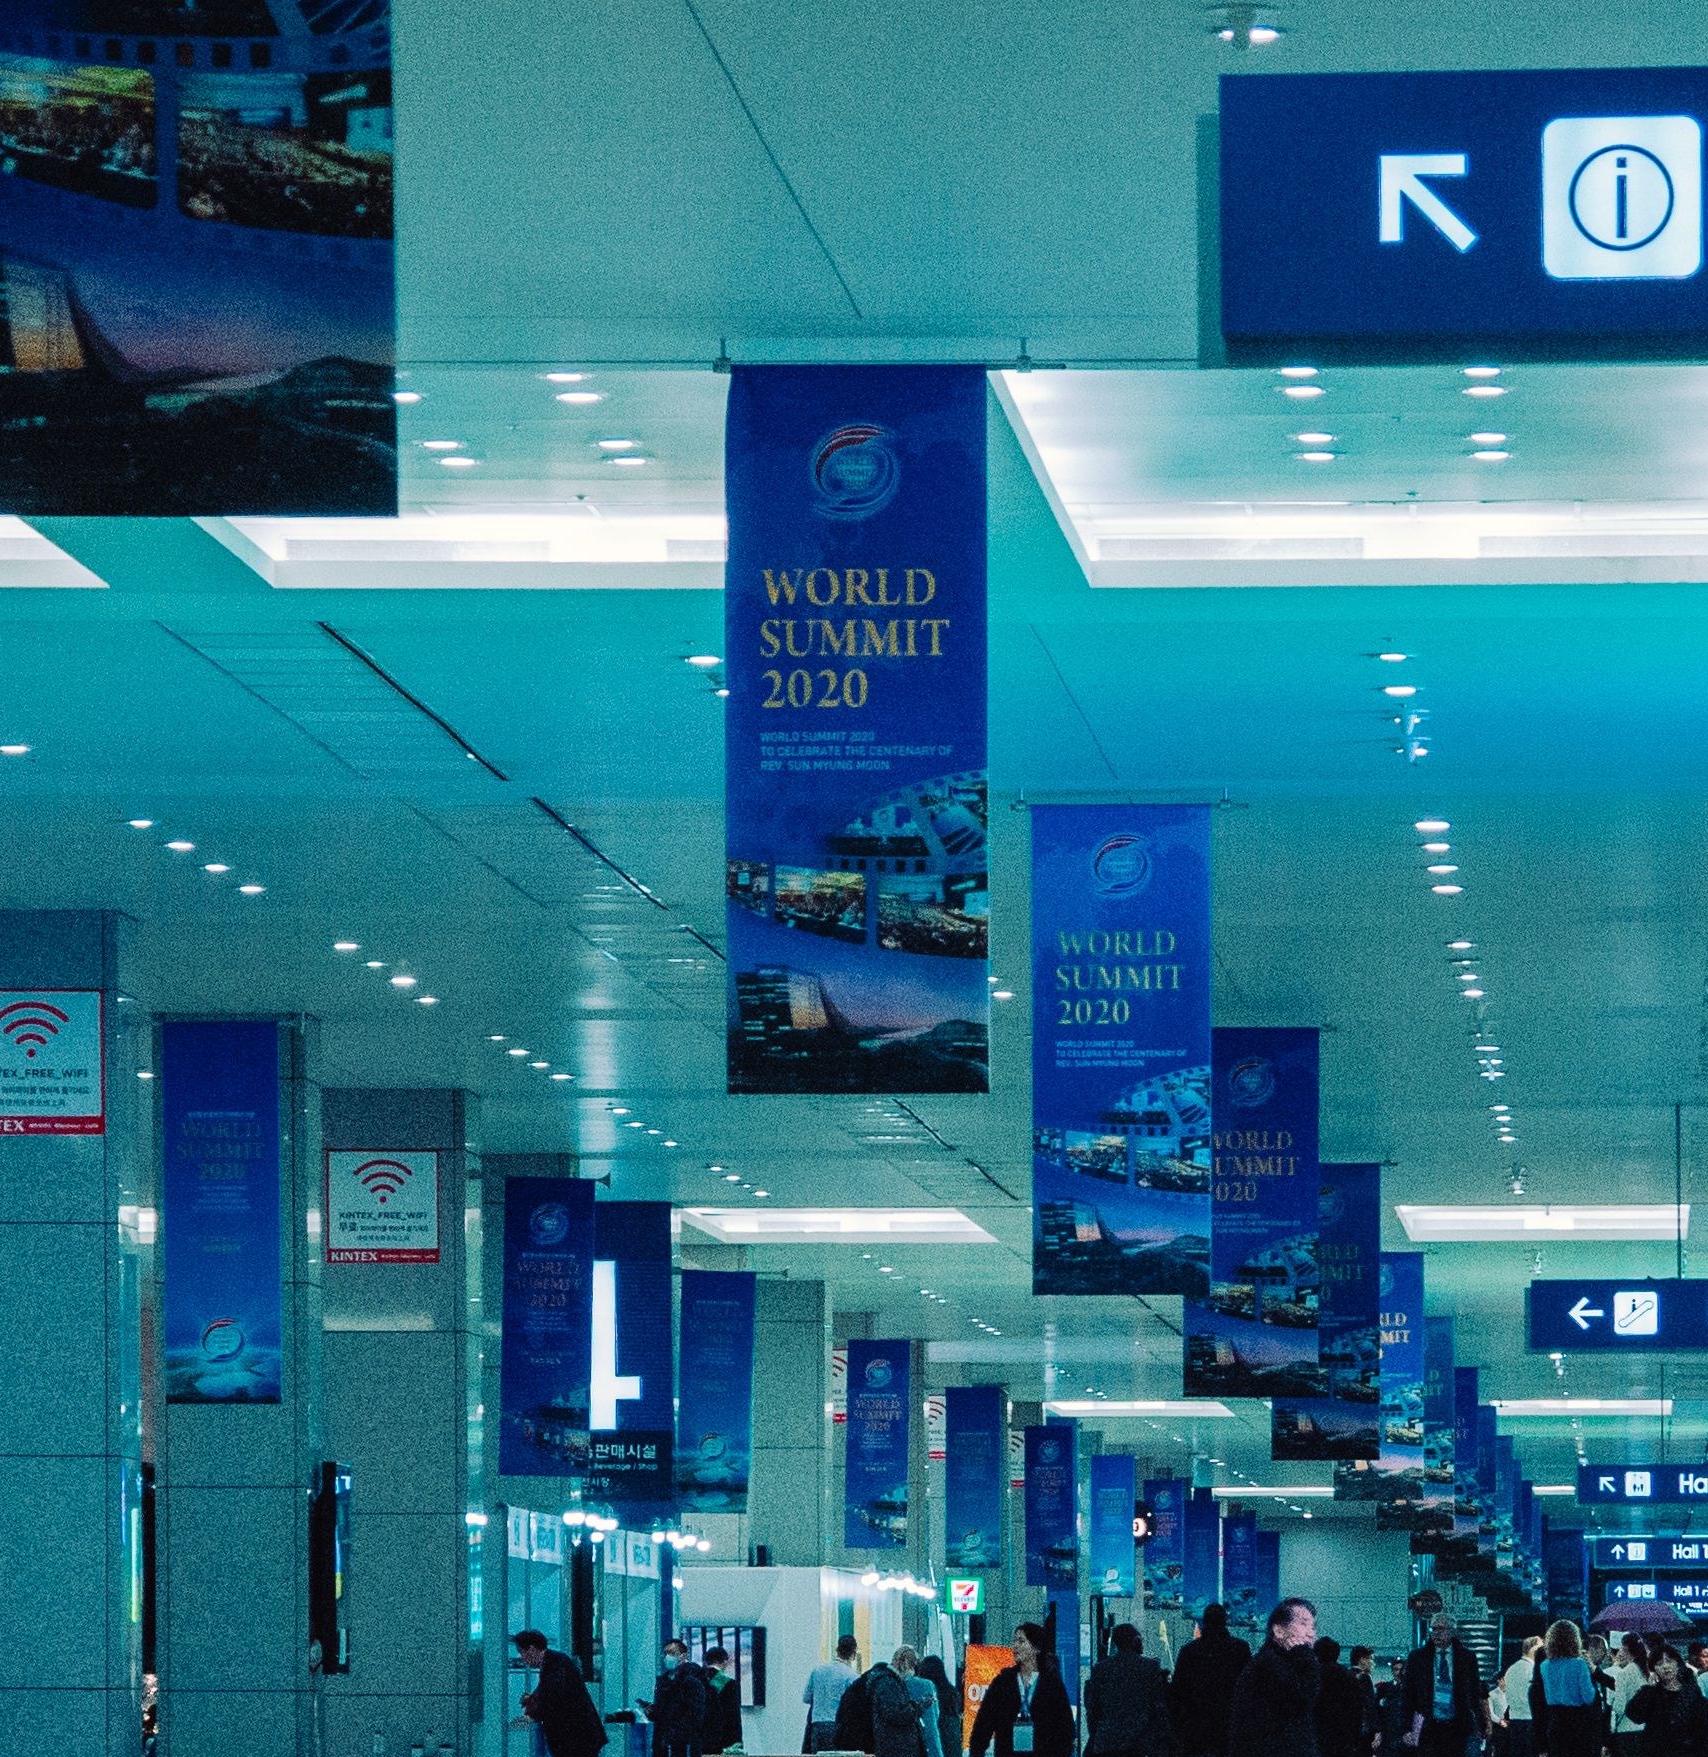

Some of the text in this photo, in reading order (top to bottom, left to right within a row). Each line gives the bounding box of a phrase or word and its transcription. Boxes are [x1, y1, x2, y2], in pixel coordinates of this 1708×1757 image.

[762, 567, 936, 606] WORLD
[759, 618, 950, 658] SUMMIT
[760, 669, 869, 709] 2020
[760, 730, 876, 742] WORLD SUMMIT 2020
[760, 744, 954, 757] TO CELEBRATE THE CENTENARY OF
[787, 759, 811, 771] SUN
[813, 759, 855, 771] MYUNG
[856, 759, 891, 771] MOON
[1058, 930, 1176, 956] WORLD
[1056, 964, 1185, 990] SUMMIT
[1057, 997, 1131, 1025] 2020
[1215, 1156, 1300, 1176] UMMIT
[1215, 1181, 1258, 1202] 020
[331, 1251, 388, 1262] KINTEX
[589, 1443, 658, 1460] 판매시설
[1672, 1543, 1699, 1560] Hall
[1673, 1585, 1700, 1597] Hall 1
